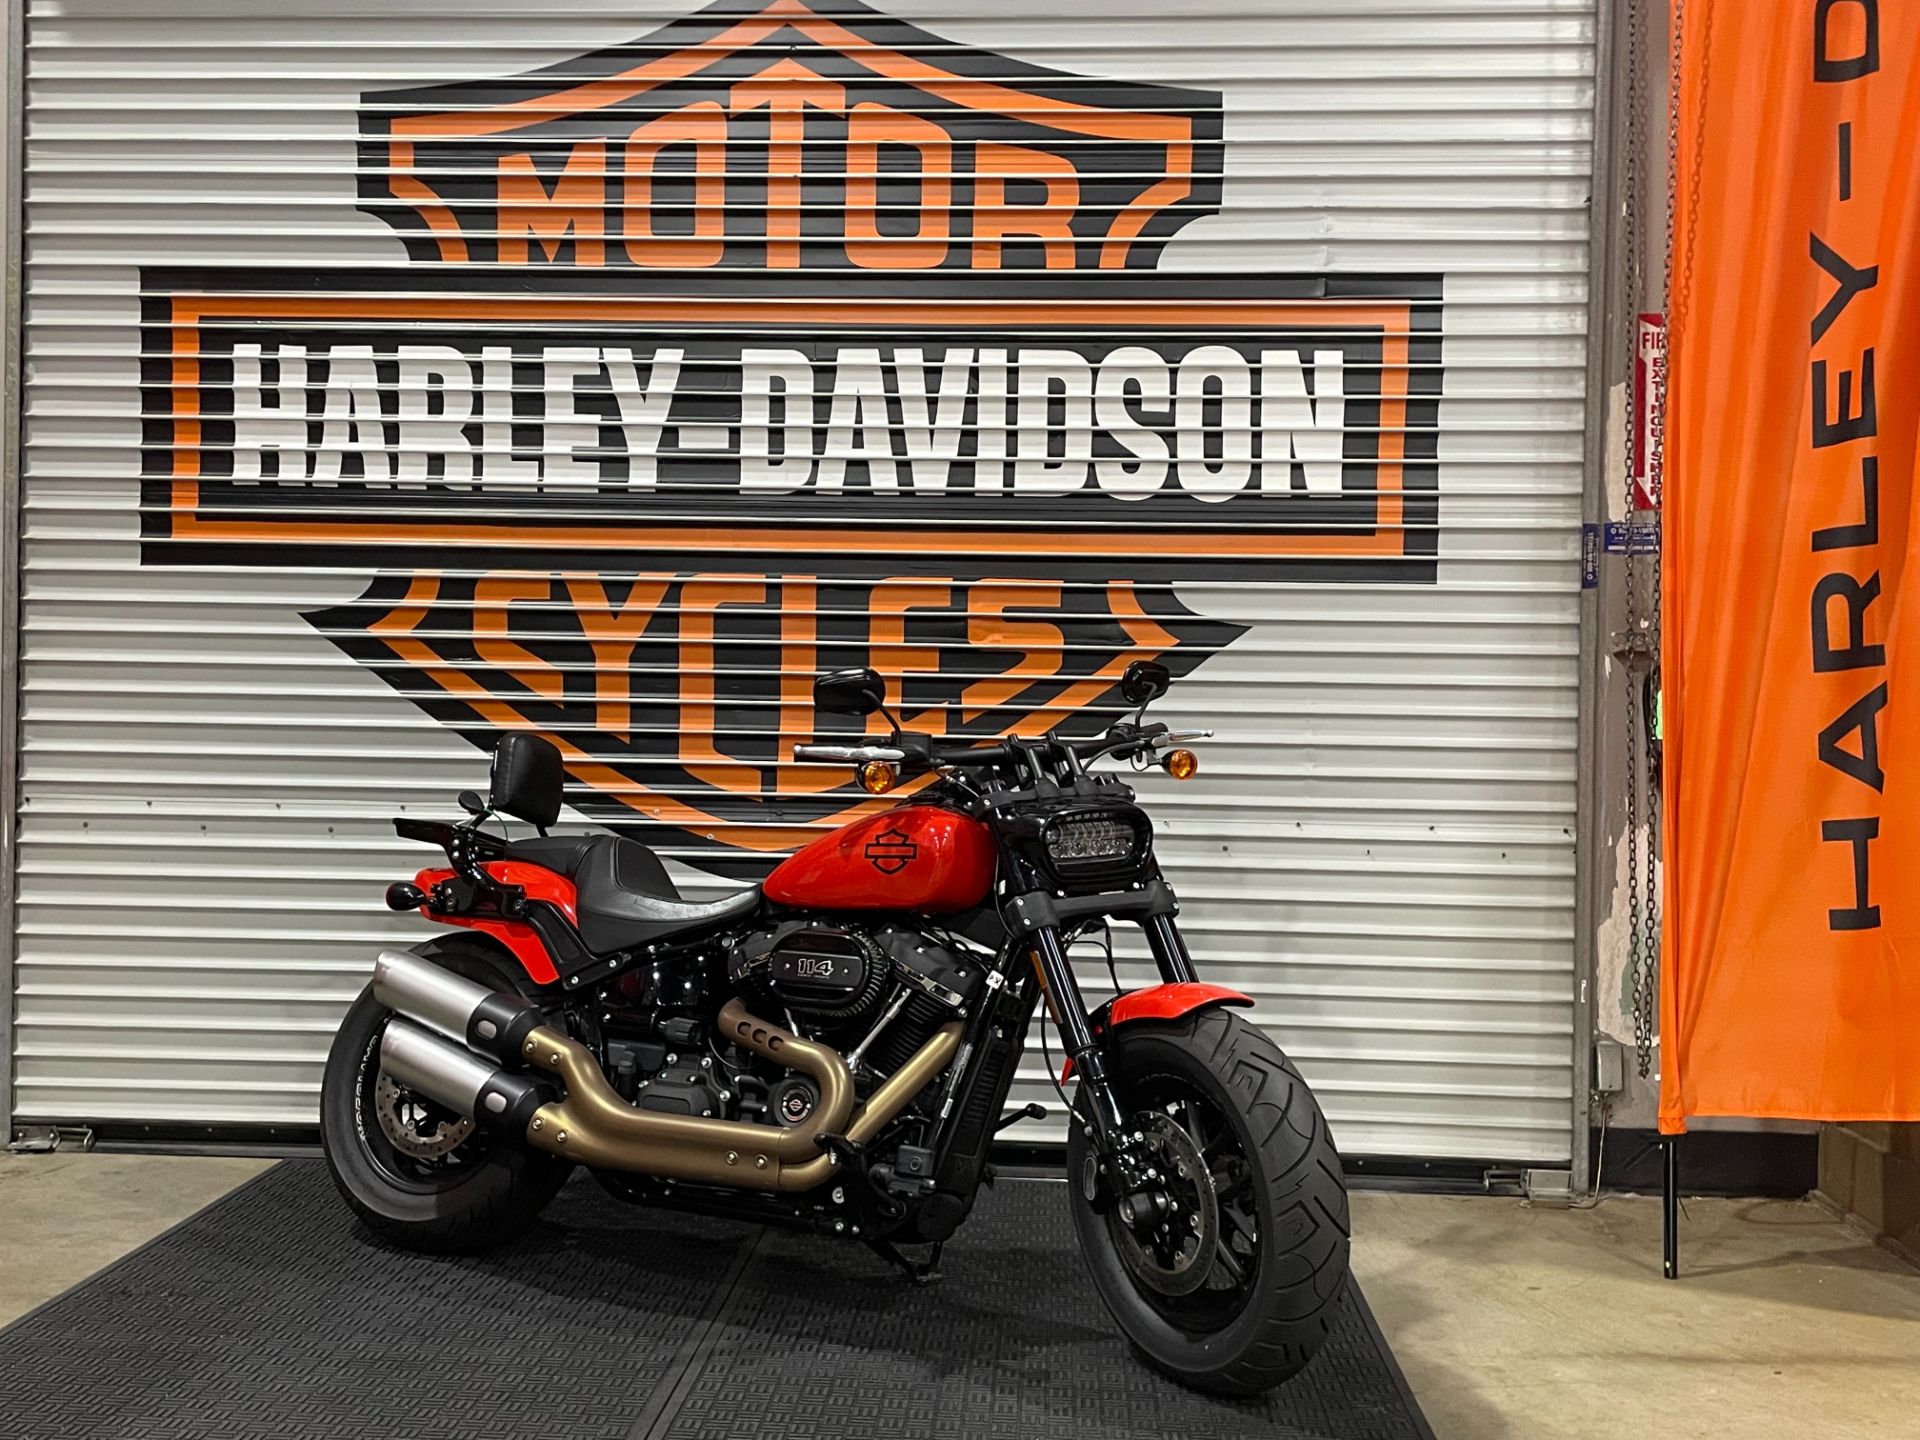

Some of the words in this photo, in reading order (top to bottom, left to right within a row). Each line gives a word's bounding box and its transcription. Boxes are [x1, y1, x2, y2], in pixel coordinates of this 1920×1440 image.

[497, 58, 1080, 269] MOTOR
[231, 342, 1345, 502] HARLEY-DAVIDSON
[473, 573, 1064, 802] CYCLES
[798, 958, 834, 976] 114
